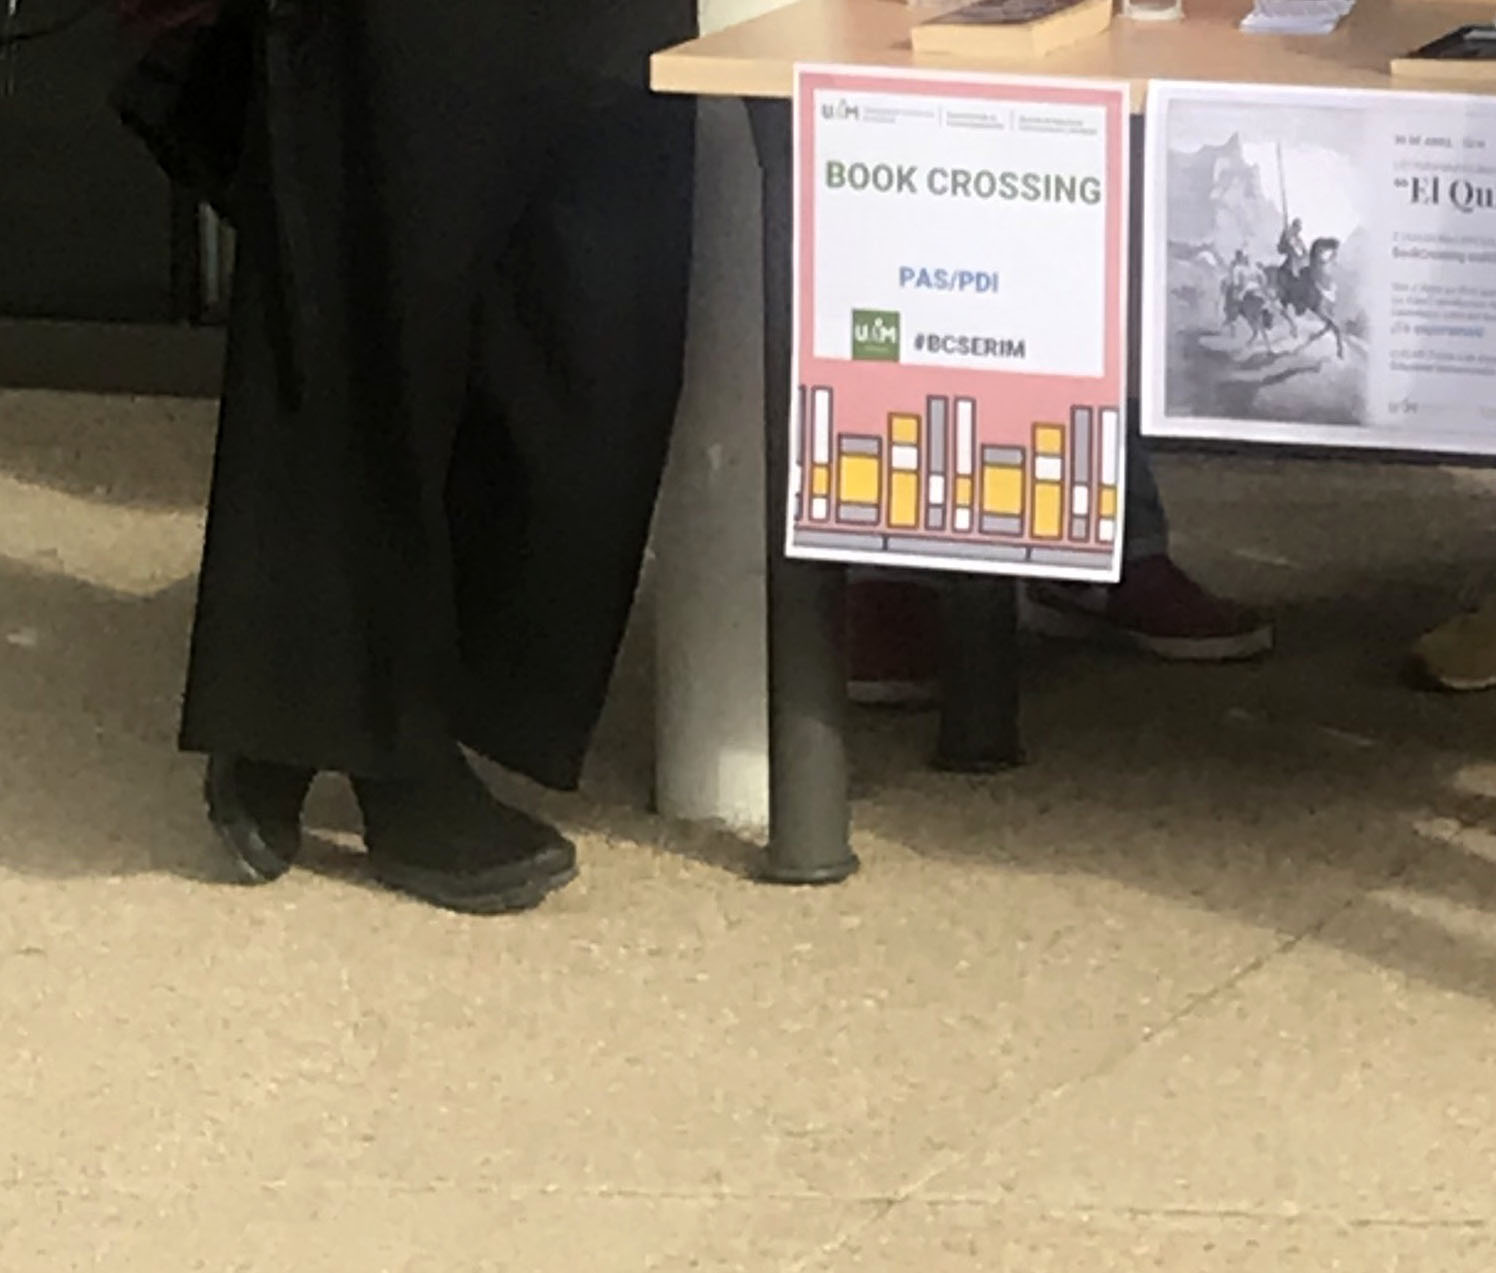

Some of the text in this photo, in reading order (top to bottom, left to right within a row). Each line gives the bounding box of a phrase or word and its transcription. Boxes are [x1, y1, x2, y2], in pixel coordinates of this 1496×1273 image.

[825, 160, 1102, 205] BOOK CROSSING
[898, 266, 999, 294] PAS/PDI
[913, 332, 1027, 360] #BCSERIM
